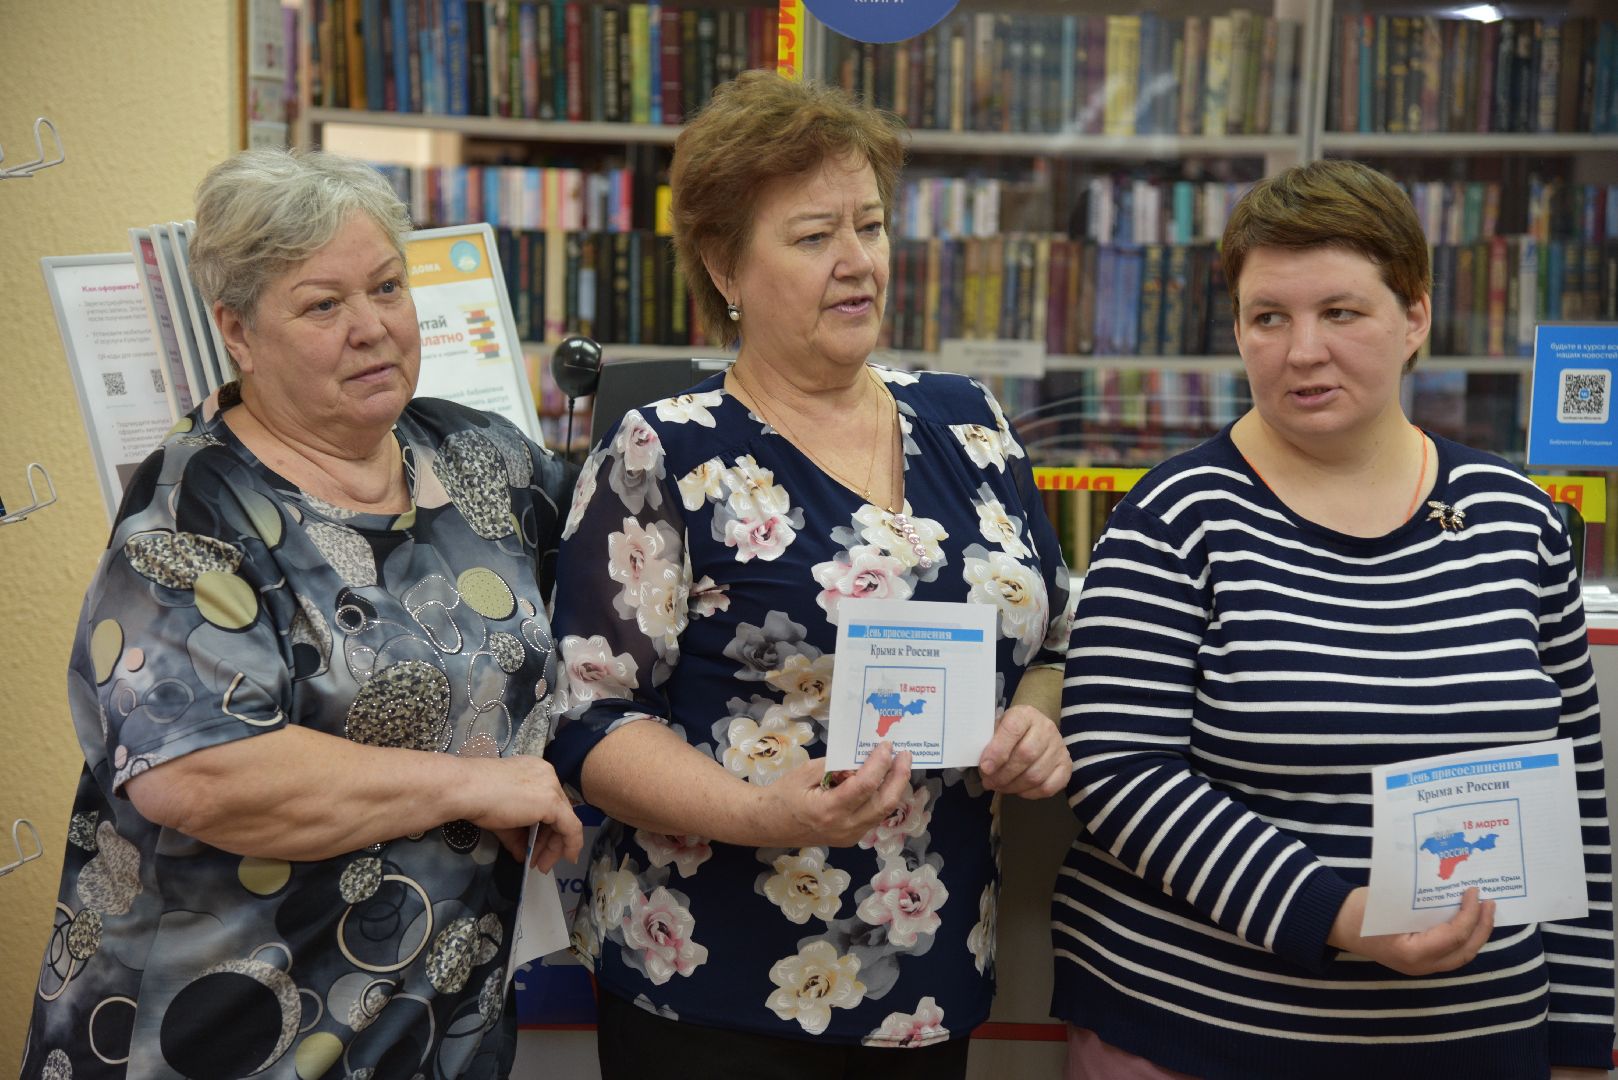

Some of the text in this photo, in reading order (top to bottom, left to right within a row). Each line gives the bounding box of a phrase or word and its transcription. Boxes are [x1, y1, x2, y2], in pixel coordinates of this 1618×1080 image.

[1583, 343, 1607, 352] курсе
[1556, 351, 1618, 360] наших новостей
[863, 626, 952, 641] День присоединения
[870, 644, 940, 659] Крыма к России
[900, 683, 936, 696] 18 марта
[1406, 760, 1522, 786] День присоединения
[1417, 780, 1510, 803] Крыма к России
[1463, 817, 1510, 831] 18 марта
[1417, 886, 1434, 896] День
[1501, 874, 1521, 884] Крым
[1482, 883, 1523, 894] Федерации
